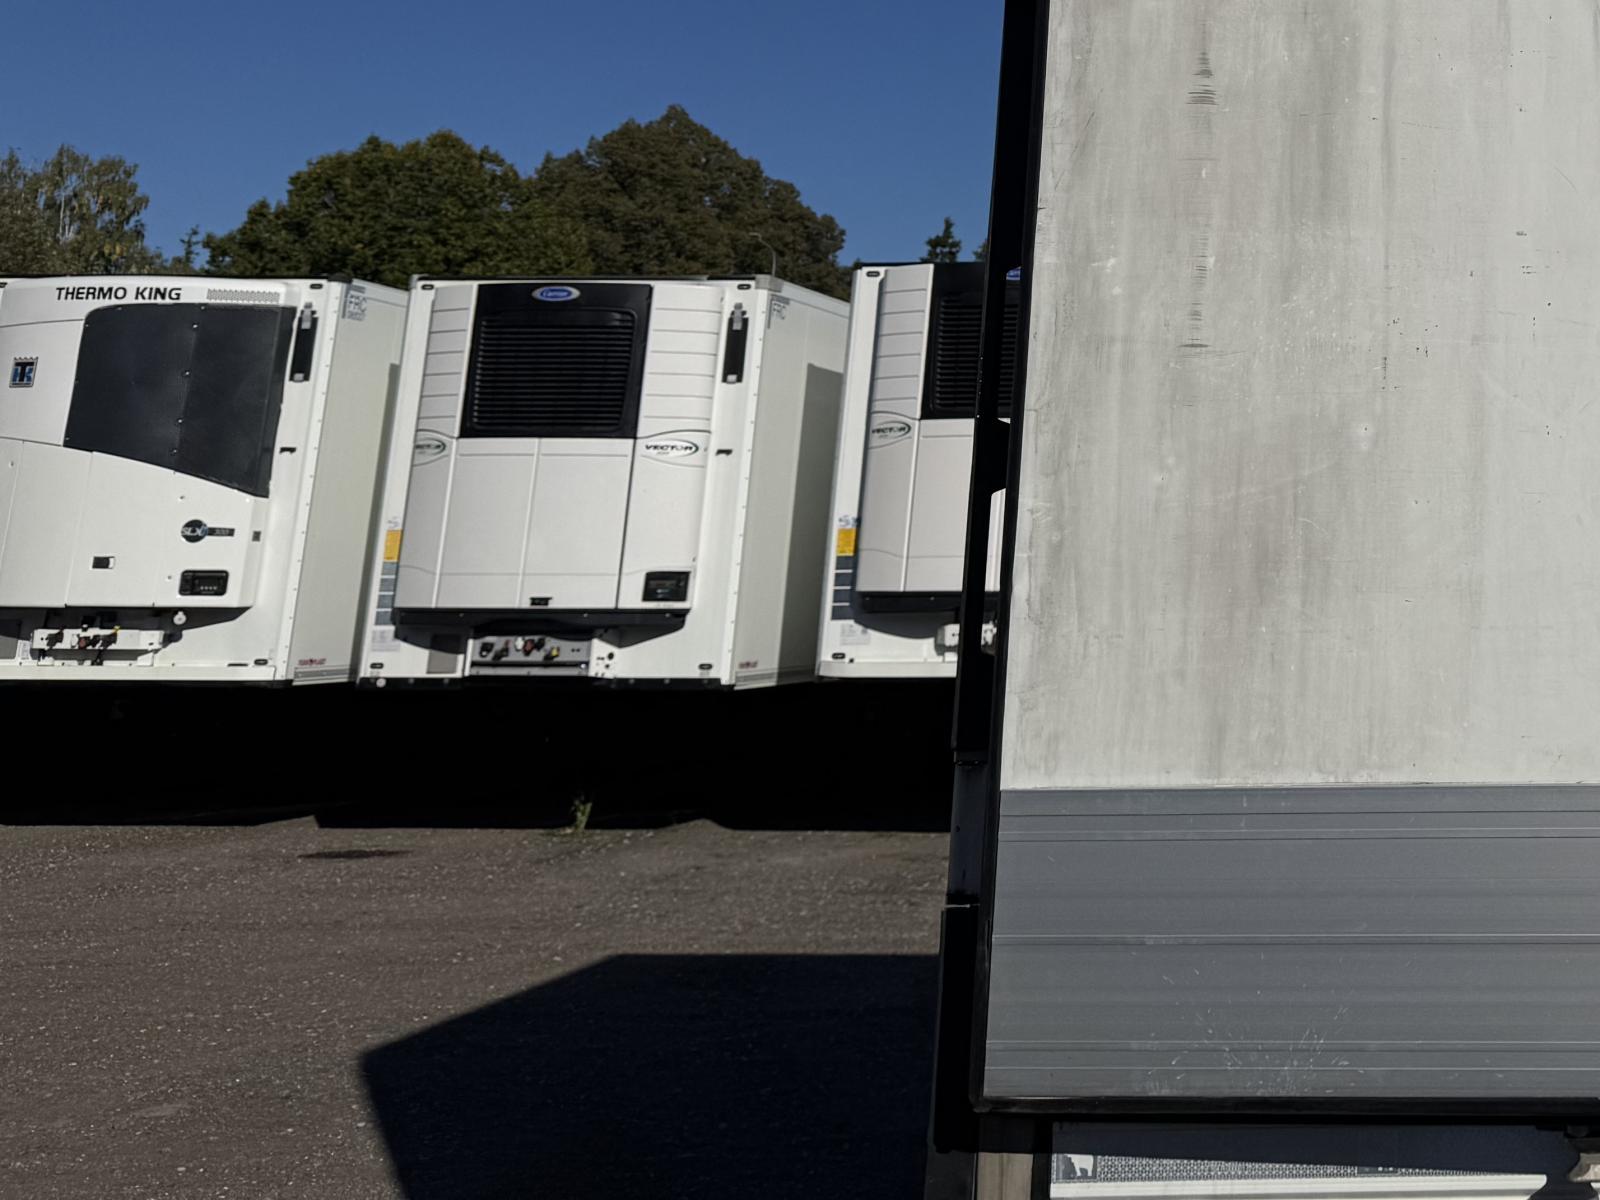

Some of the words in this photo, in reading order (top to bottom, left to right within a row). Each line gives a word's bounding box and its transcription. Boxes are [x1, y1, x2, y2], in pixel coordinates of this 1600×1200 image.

[56, 287, 127, 301] THERMO
[134, 287, 182, 301] KING
[645, 443, 694, 452] VECTOR
